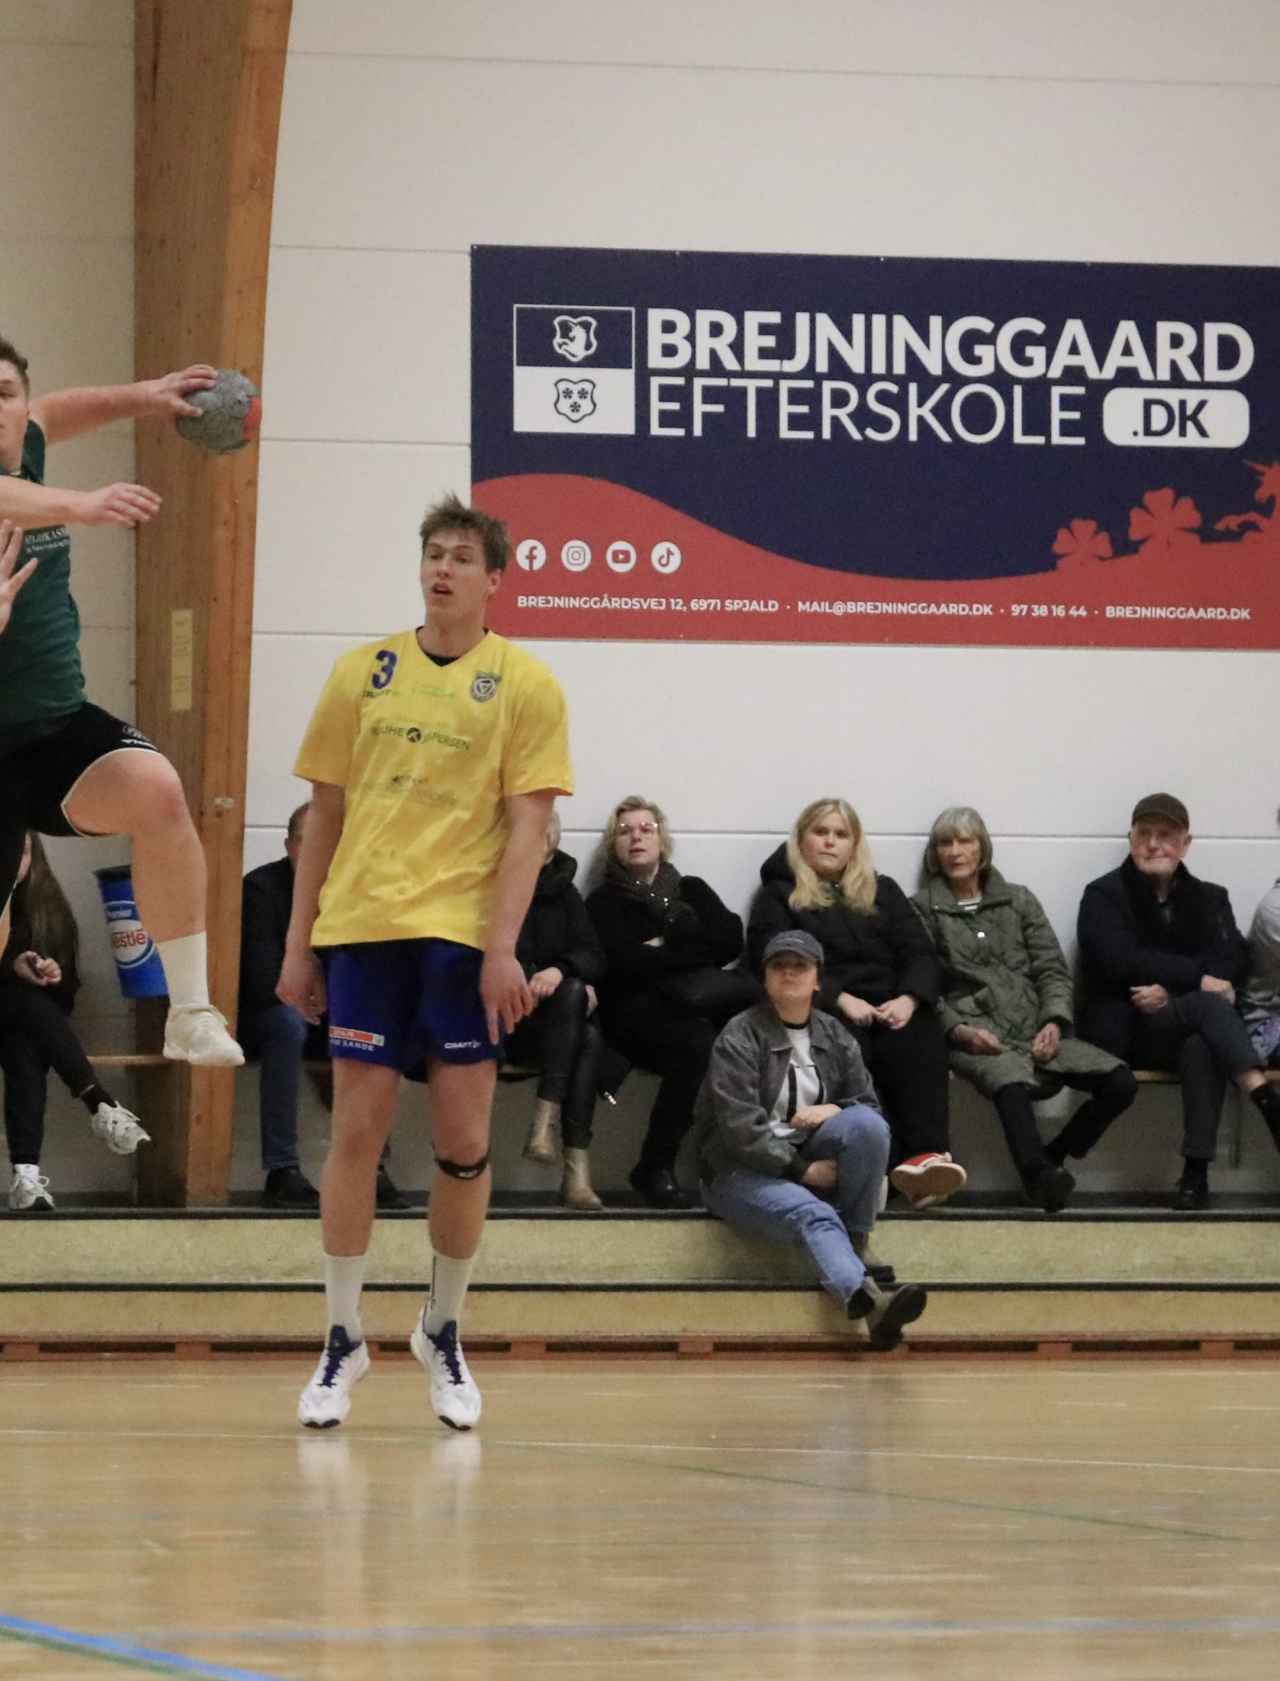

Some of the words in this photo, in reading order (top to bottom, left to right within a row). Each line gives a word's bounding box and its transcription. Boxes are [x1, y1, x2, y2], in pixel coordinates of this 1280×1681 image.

[646, 306, 1255, 383] BREJNINGGAARD
[648, 376, 1087, 446] EFTERSKOLE
[1131, 397, 1210, 439] .DK
[516, 594, 666, 610] BREJNINGGÅRDSVEJ
[670, 598, 687, 612] 12,
[690, 599, 721, 611] 6971
[724, 599, 779, 612] SPJALD
[797, 601, 993, 616] MAIL@BREJNINGGAARD.DK
[1010, 604, 1028, 617] 97
[1031, 604, 1048, 617] 38
[1051, 605, 1066, 618] 16
[1068, 605, 1088, 618] 44
[1105, 605, 1251, 620] BREJNINGGAARD.DK
[371, 649, 398, 690] 3
